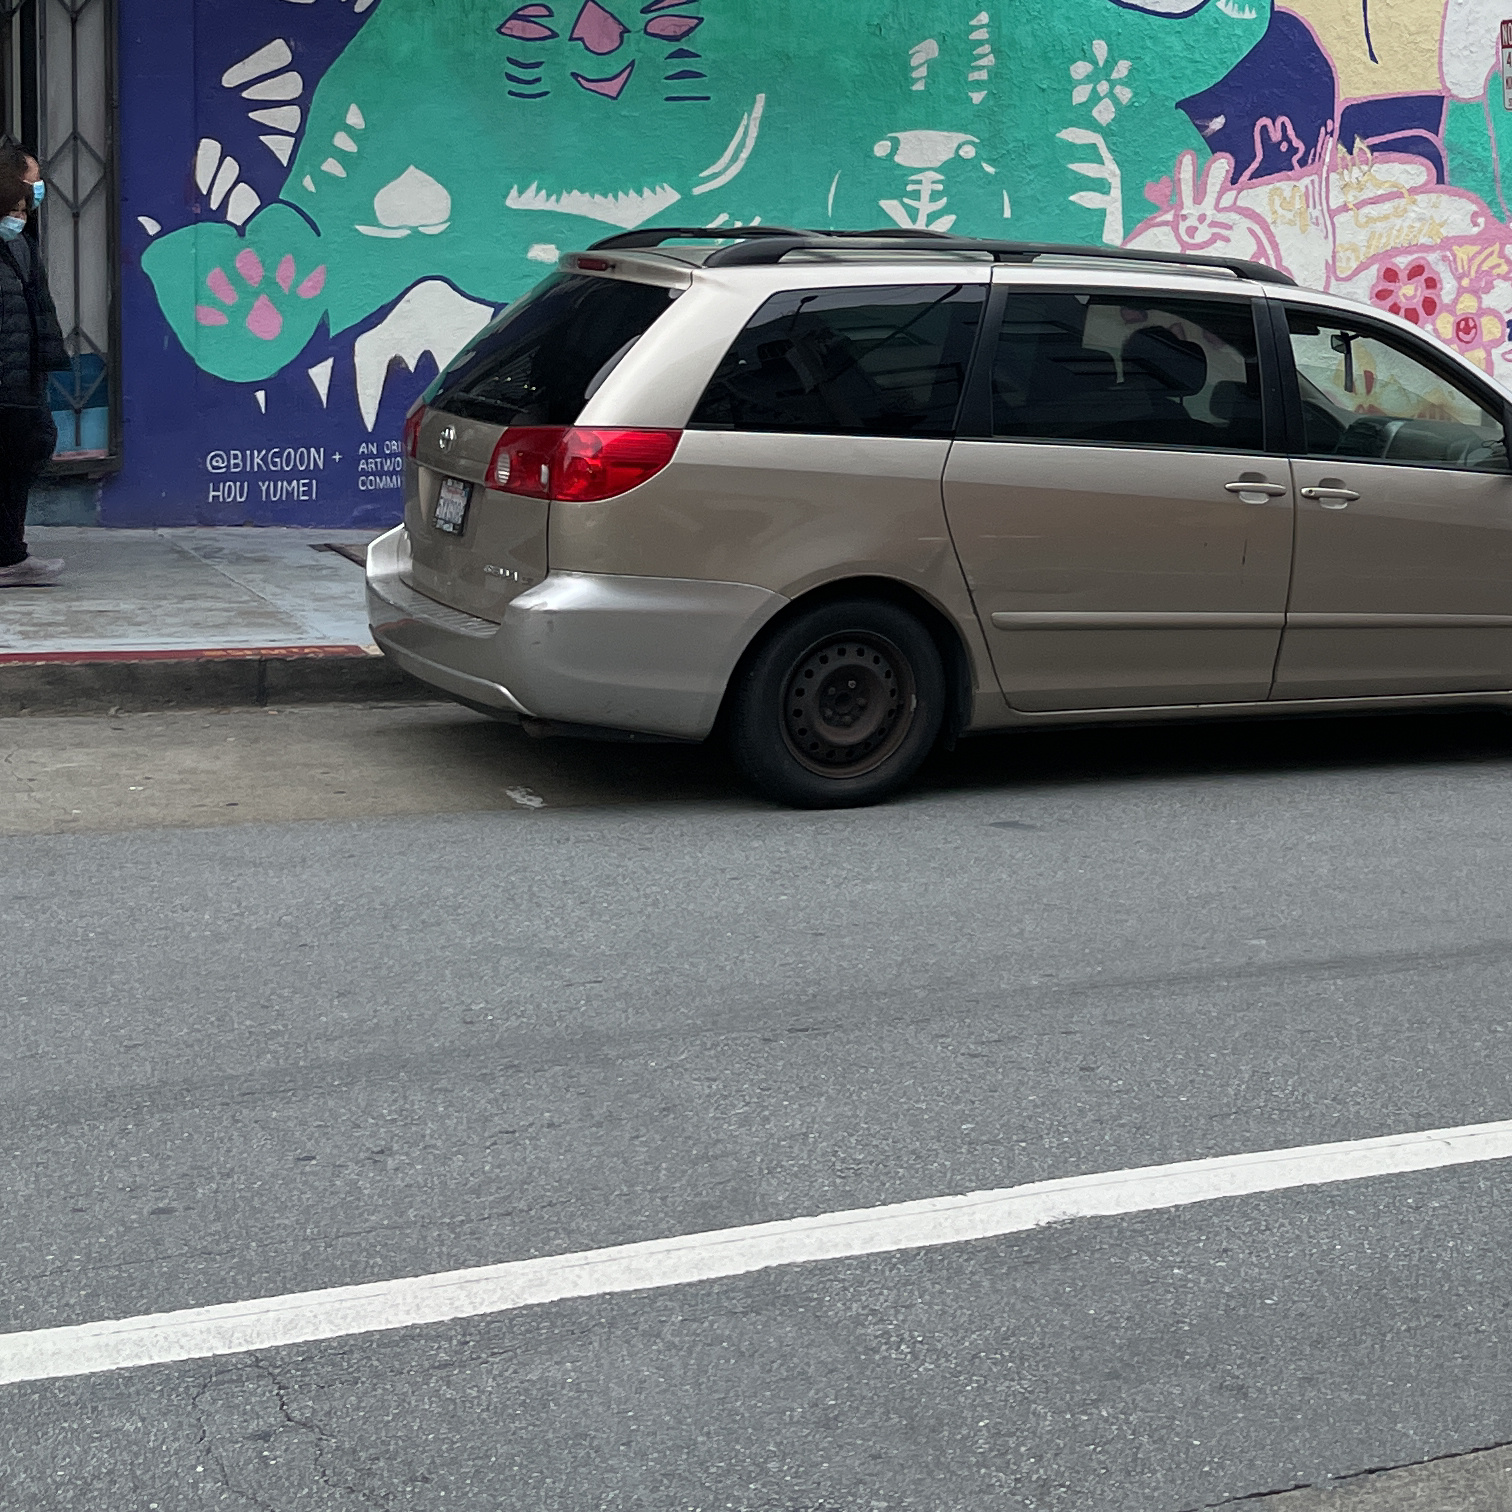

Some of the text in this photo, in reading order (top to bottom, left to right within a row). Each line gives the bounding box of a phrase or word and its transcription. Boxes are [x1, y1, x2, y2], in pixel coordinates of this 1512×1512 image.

[1502, 23, 1512, 46] NO
[206, 447, 324, 473] @BIKGOON
[358, 441, 377, 455] AN
[384, 440, 403, 454] ORI
[358, 456, 404, 472] ARTWO
[208, 479, 317, 503] HOU YUMEI
[358, 474, 402, 490] COMMI
